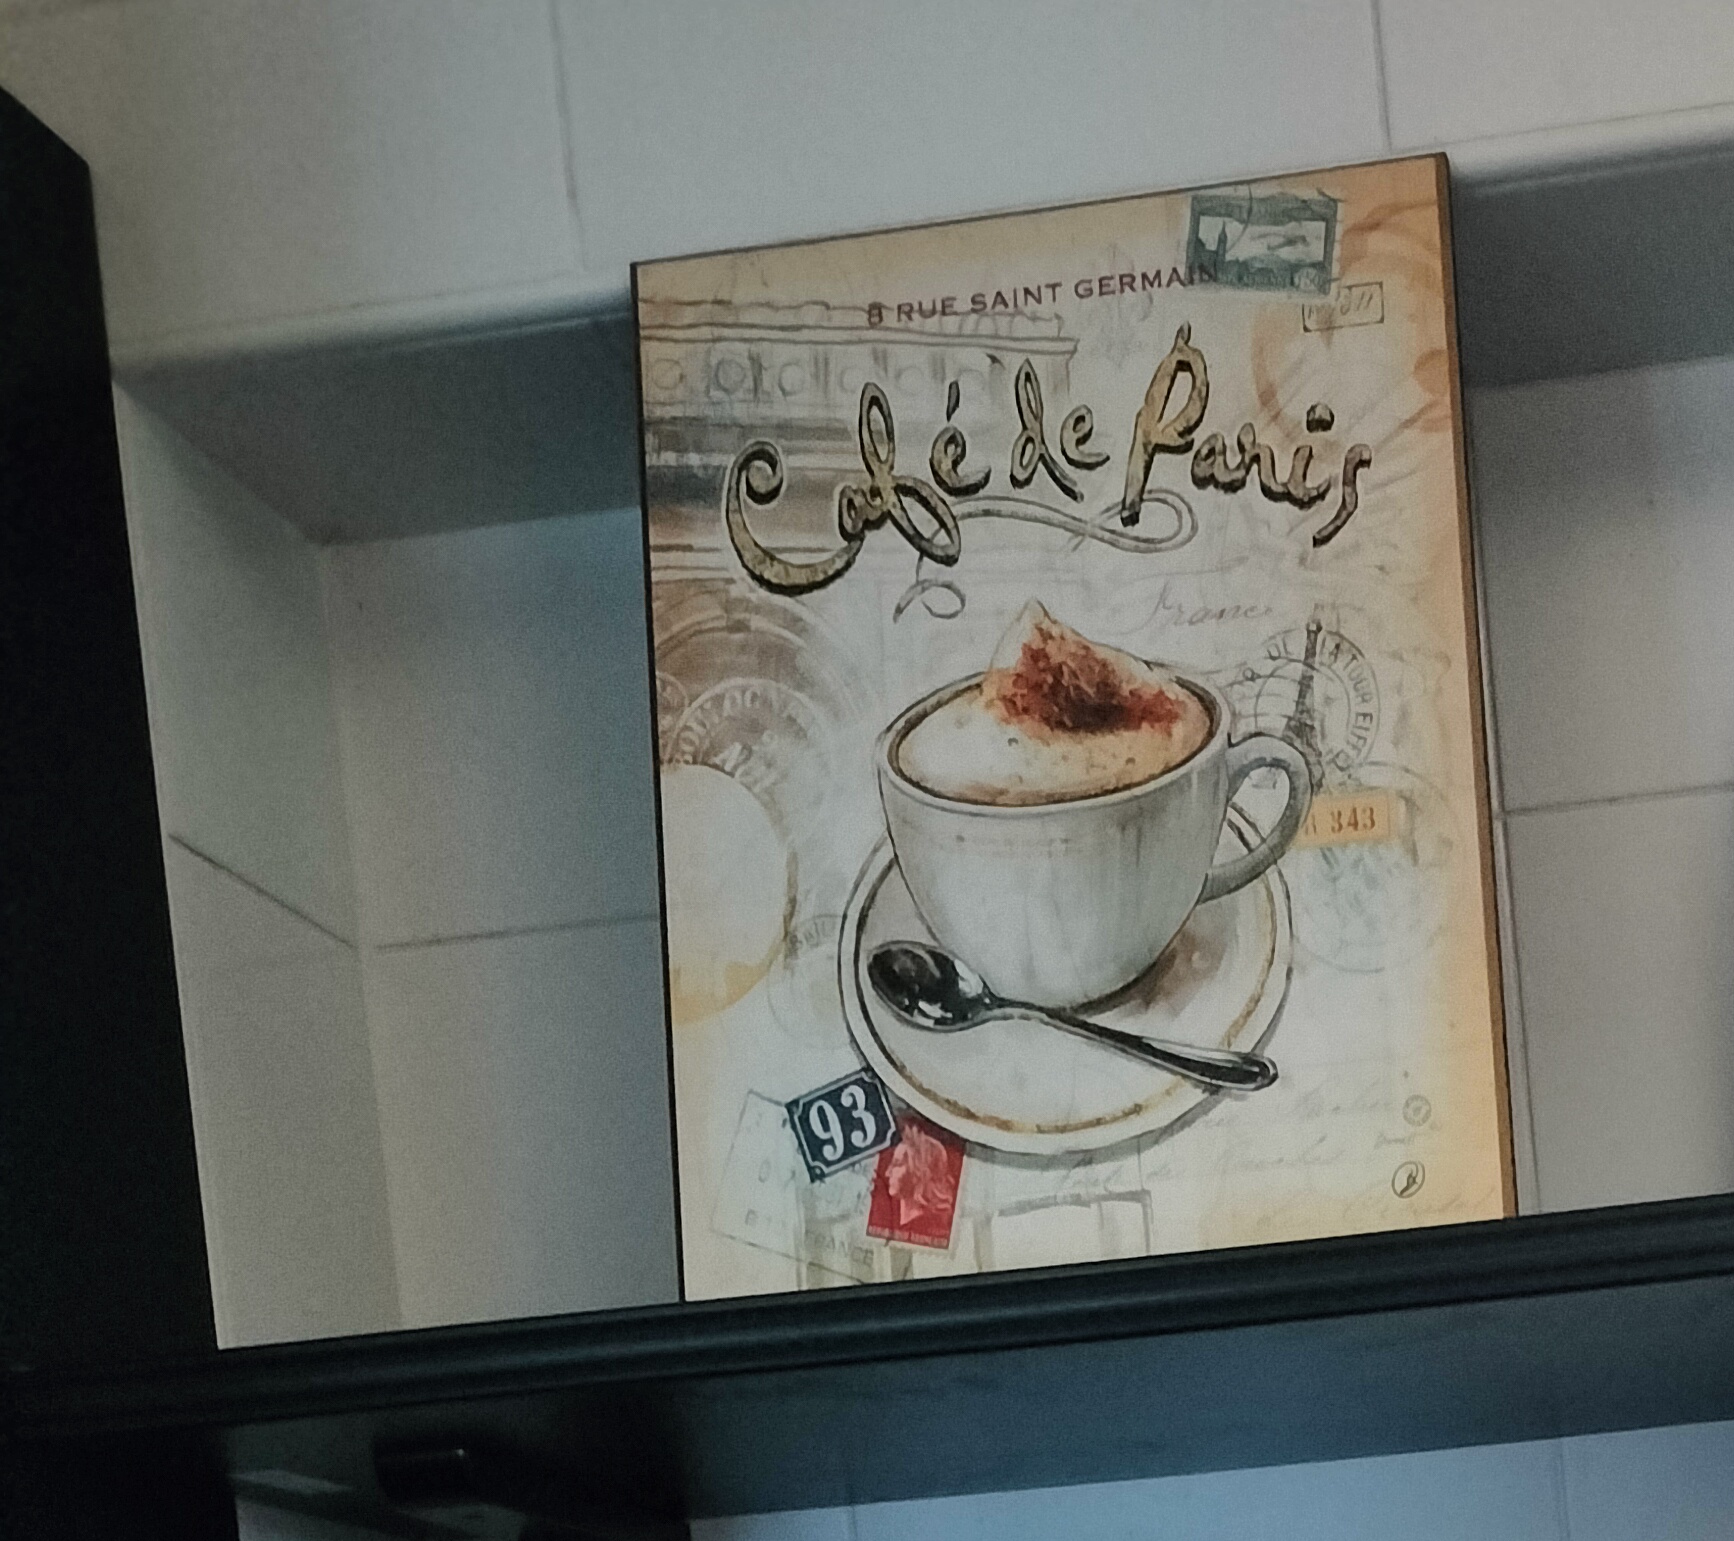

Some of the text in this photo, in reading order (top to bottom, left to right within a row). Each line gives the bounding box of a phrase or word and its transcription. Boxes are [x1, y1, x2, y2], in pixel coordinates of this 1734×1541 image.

[896, 296, 959, 323] RUE
[970, 282, 1063, 315] SAINT
[1074, 261, 1217, 300] GERMAIN
[726, 322, 1372, 596] Café de Paris
[808, 1084, 877, 1162] 93
